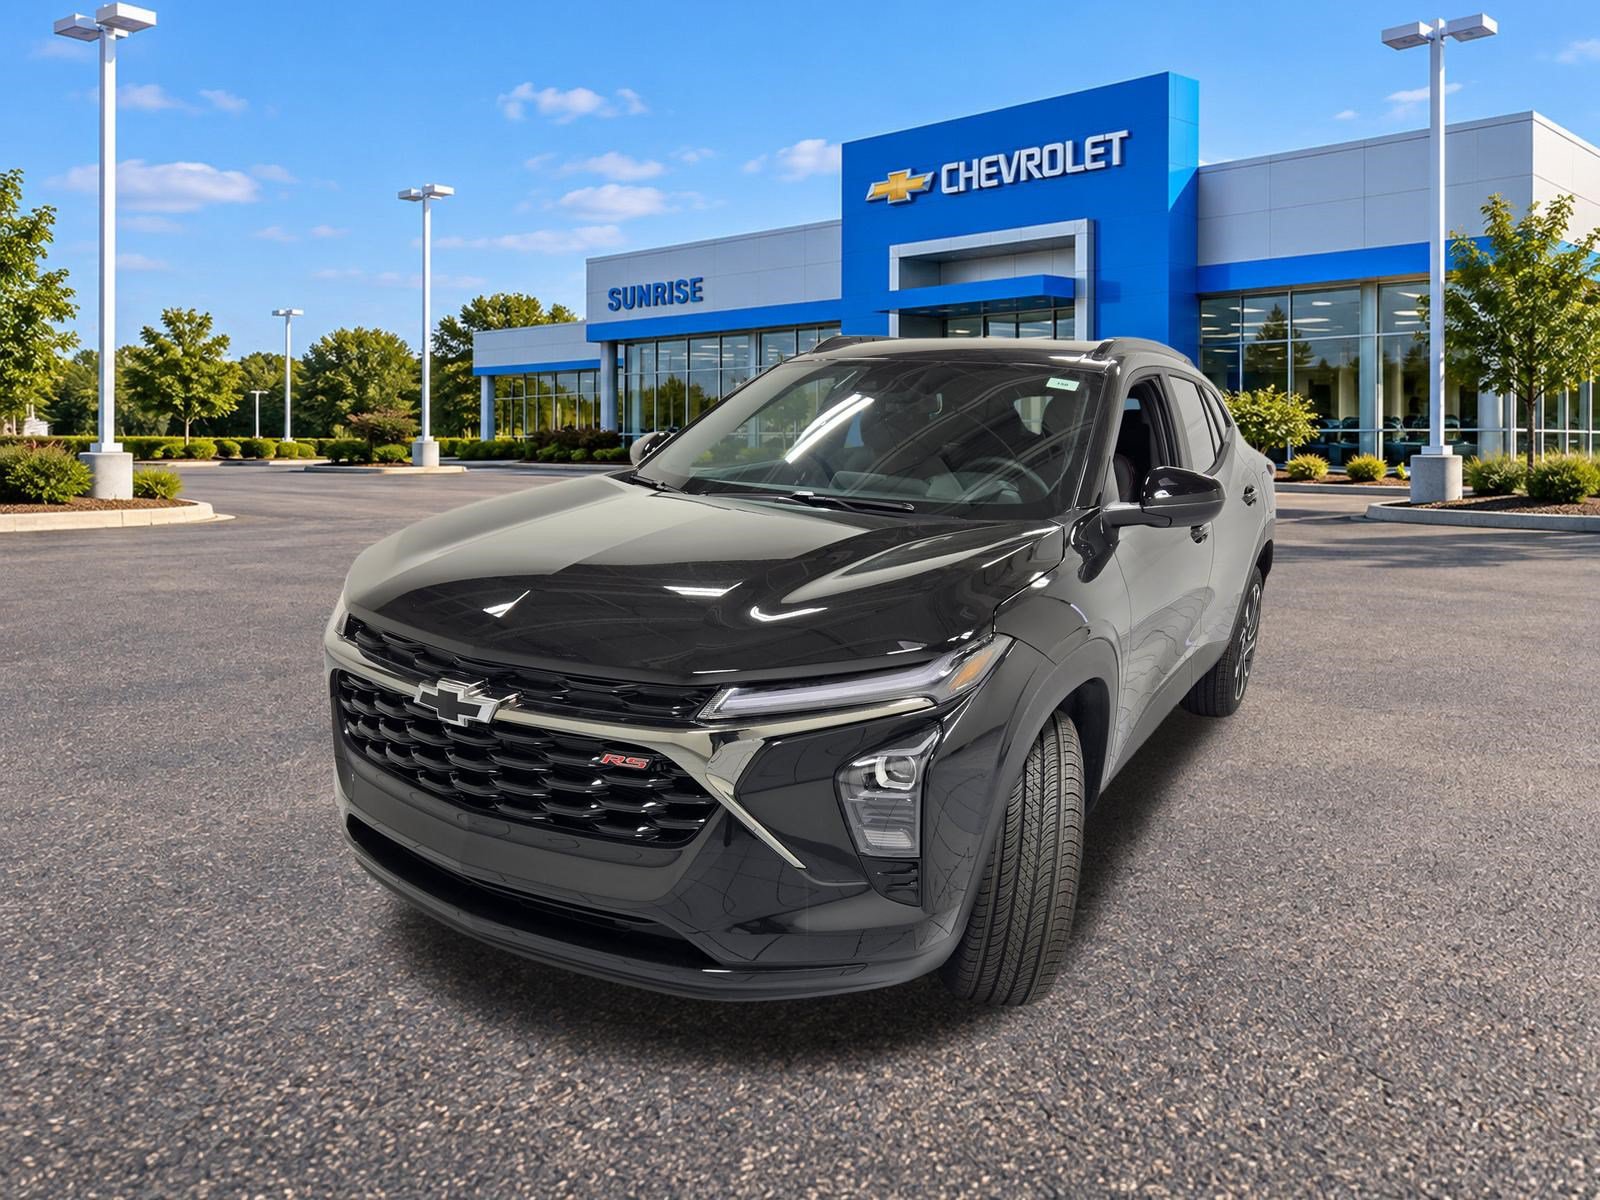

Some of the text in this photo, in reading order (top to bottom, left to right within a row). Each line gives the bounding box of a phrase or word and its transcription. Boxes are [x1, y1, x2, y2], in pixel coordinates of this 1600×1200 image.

[940, 129, 1129, 195] CHEVROLET
[607, 277, 704, 312] SUNRISE
[600, 753, 650, 769] RS
